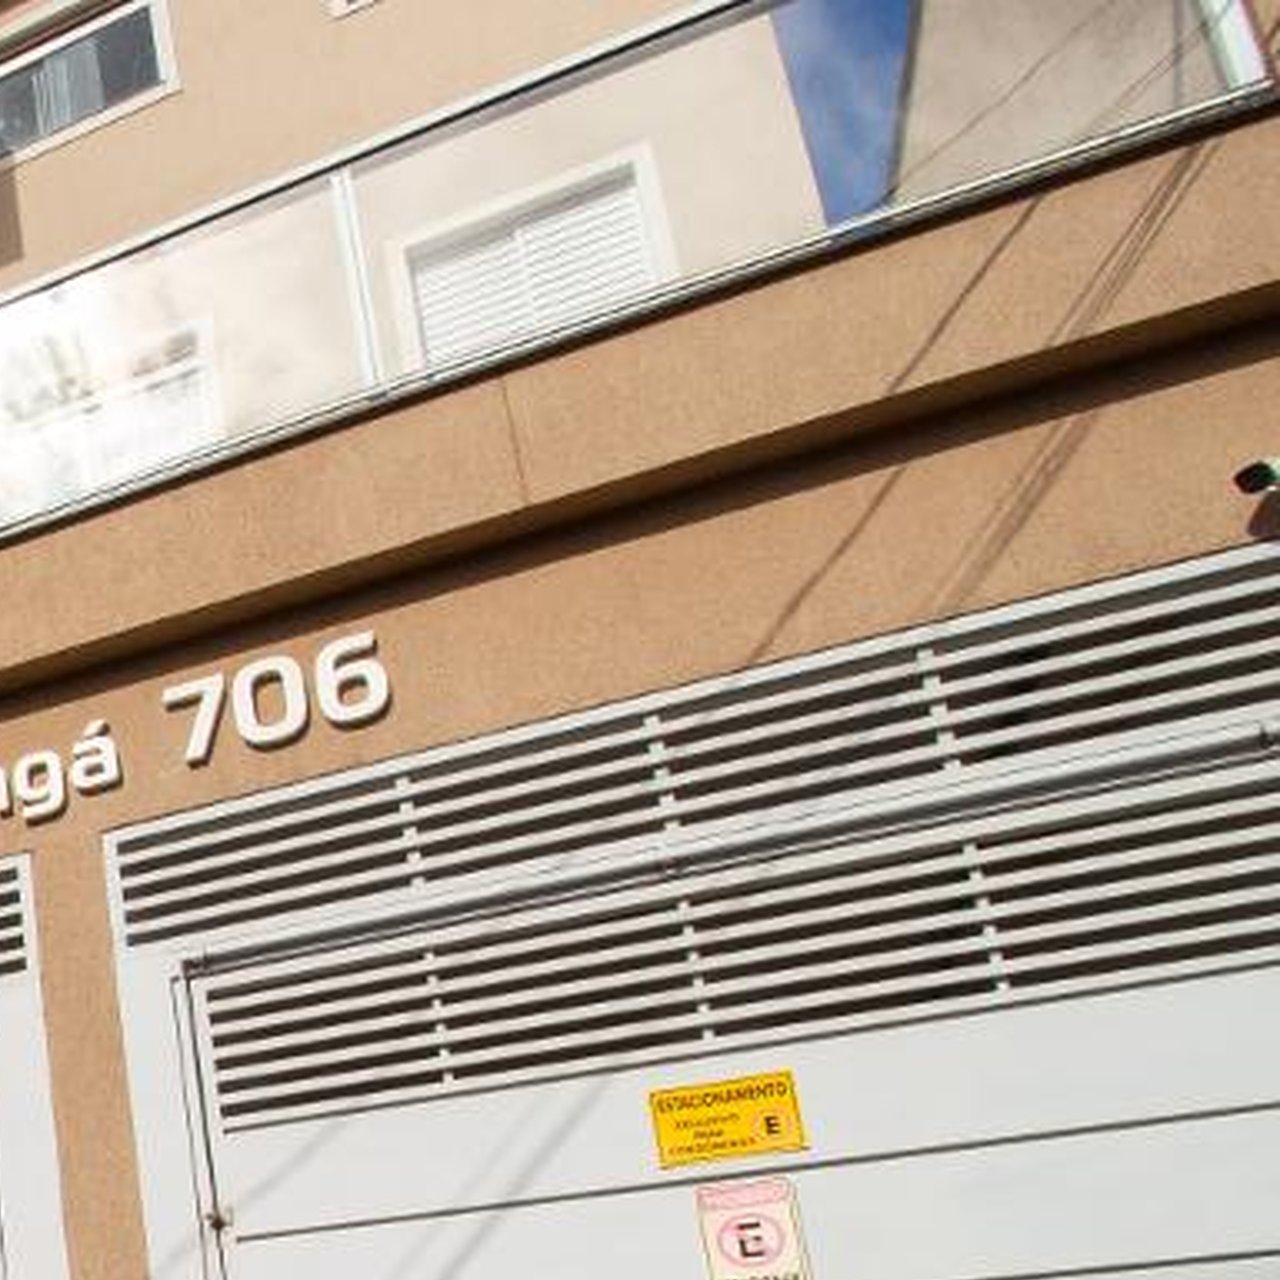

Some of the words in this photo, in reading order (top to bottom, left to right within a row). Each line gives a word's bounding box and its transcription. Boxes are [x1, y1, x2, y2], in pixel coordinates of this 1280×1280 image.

[161, 629, 392, 767] 706
[656, 1081, 788, 1113] ESTACIONAMENTO
[764, 1115, 782, 1136] E
